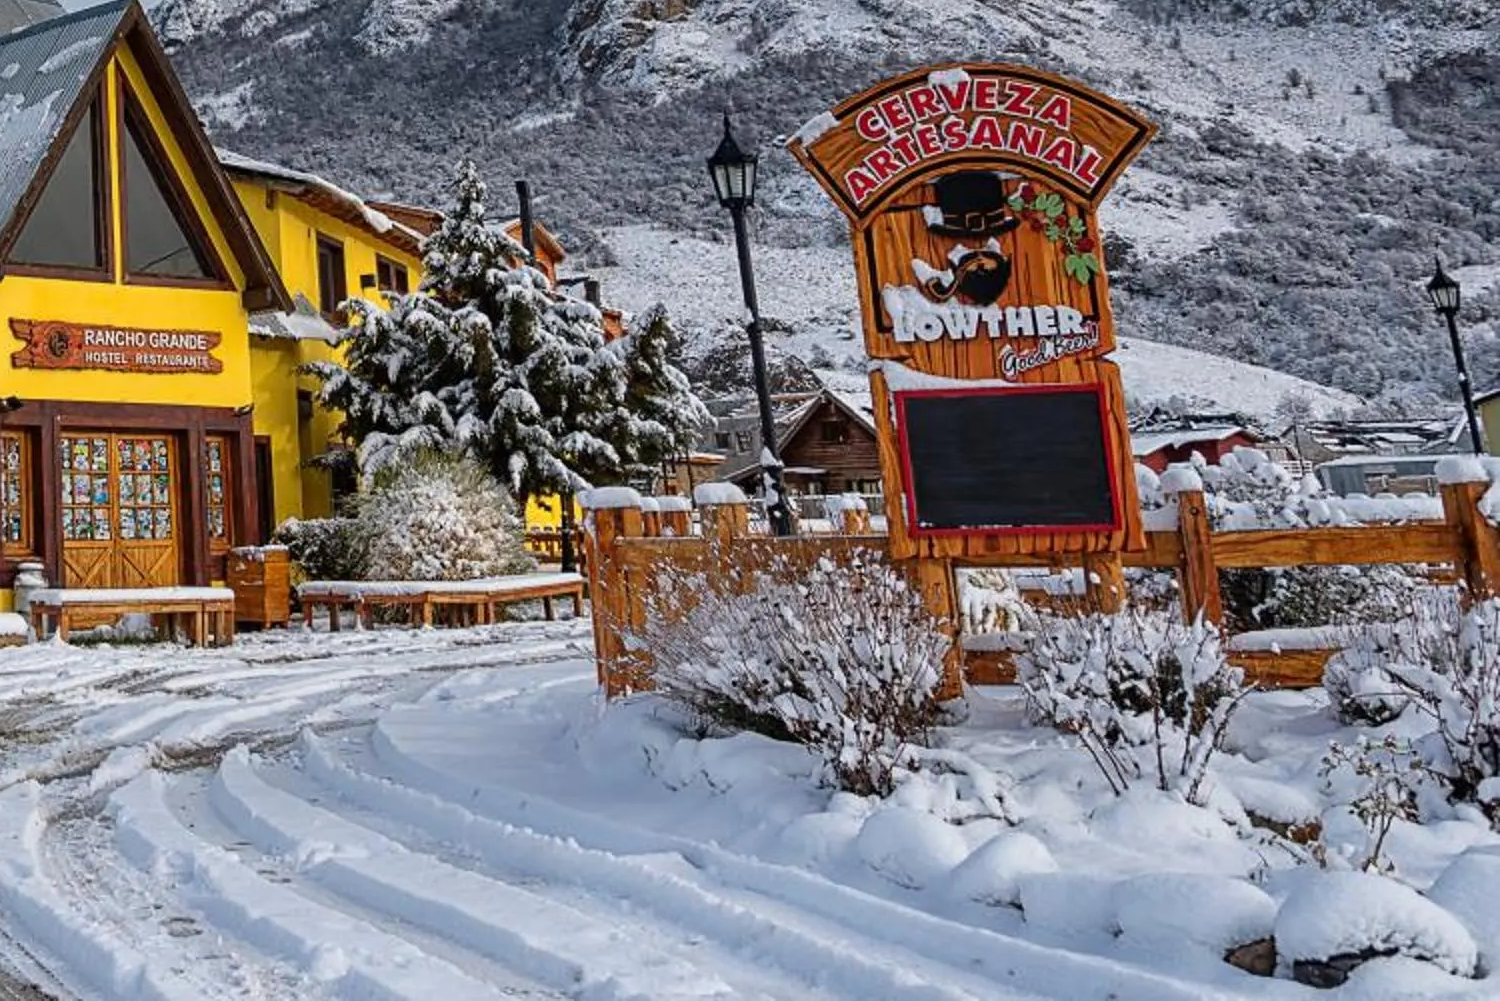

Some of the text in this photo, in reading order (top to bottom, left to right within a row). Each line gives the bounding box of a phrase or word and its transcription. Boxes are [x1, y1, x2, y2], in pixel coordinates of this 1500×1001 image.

[855, 78, 1072, 142] CERVEZA
[843, 115, 1105, 206] ARTESANAL
[84, 329, 208, 350] RANCHO GRANDE
[893, 304, 1087, 343] LOWTHER
[85, 351, 128, 364] HOSTEL
[1001, 341, 1048, 377] Good
